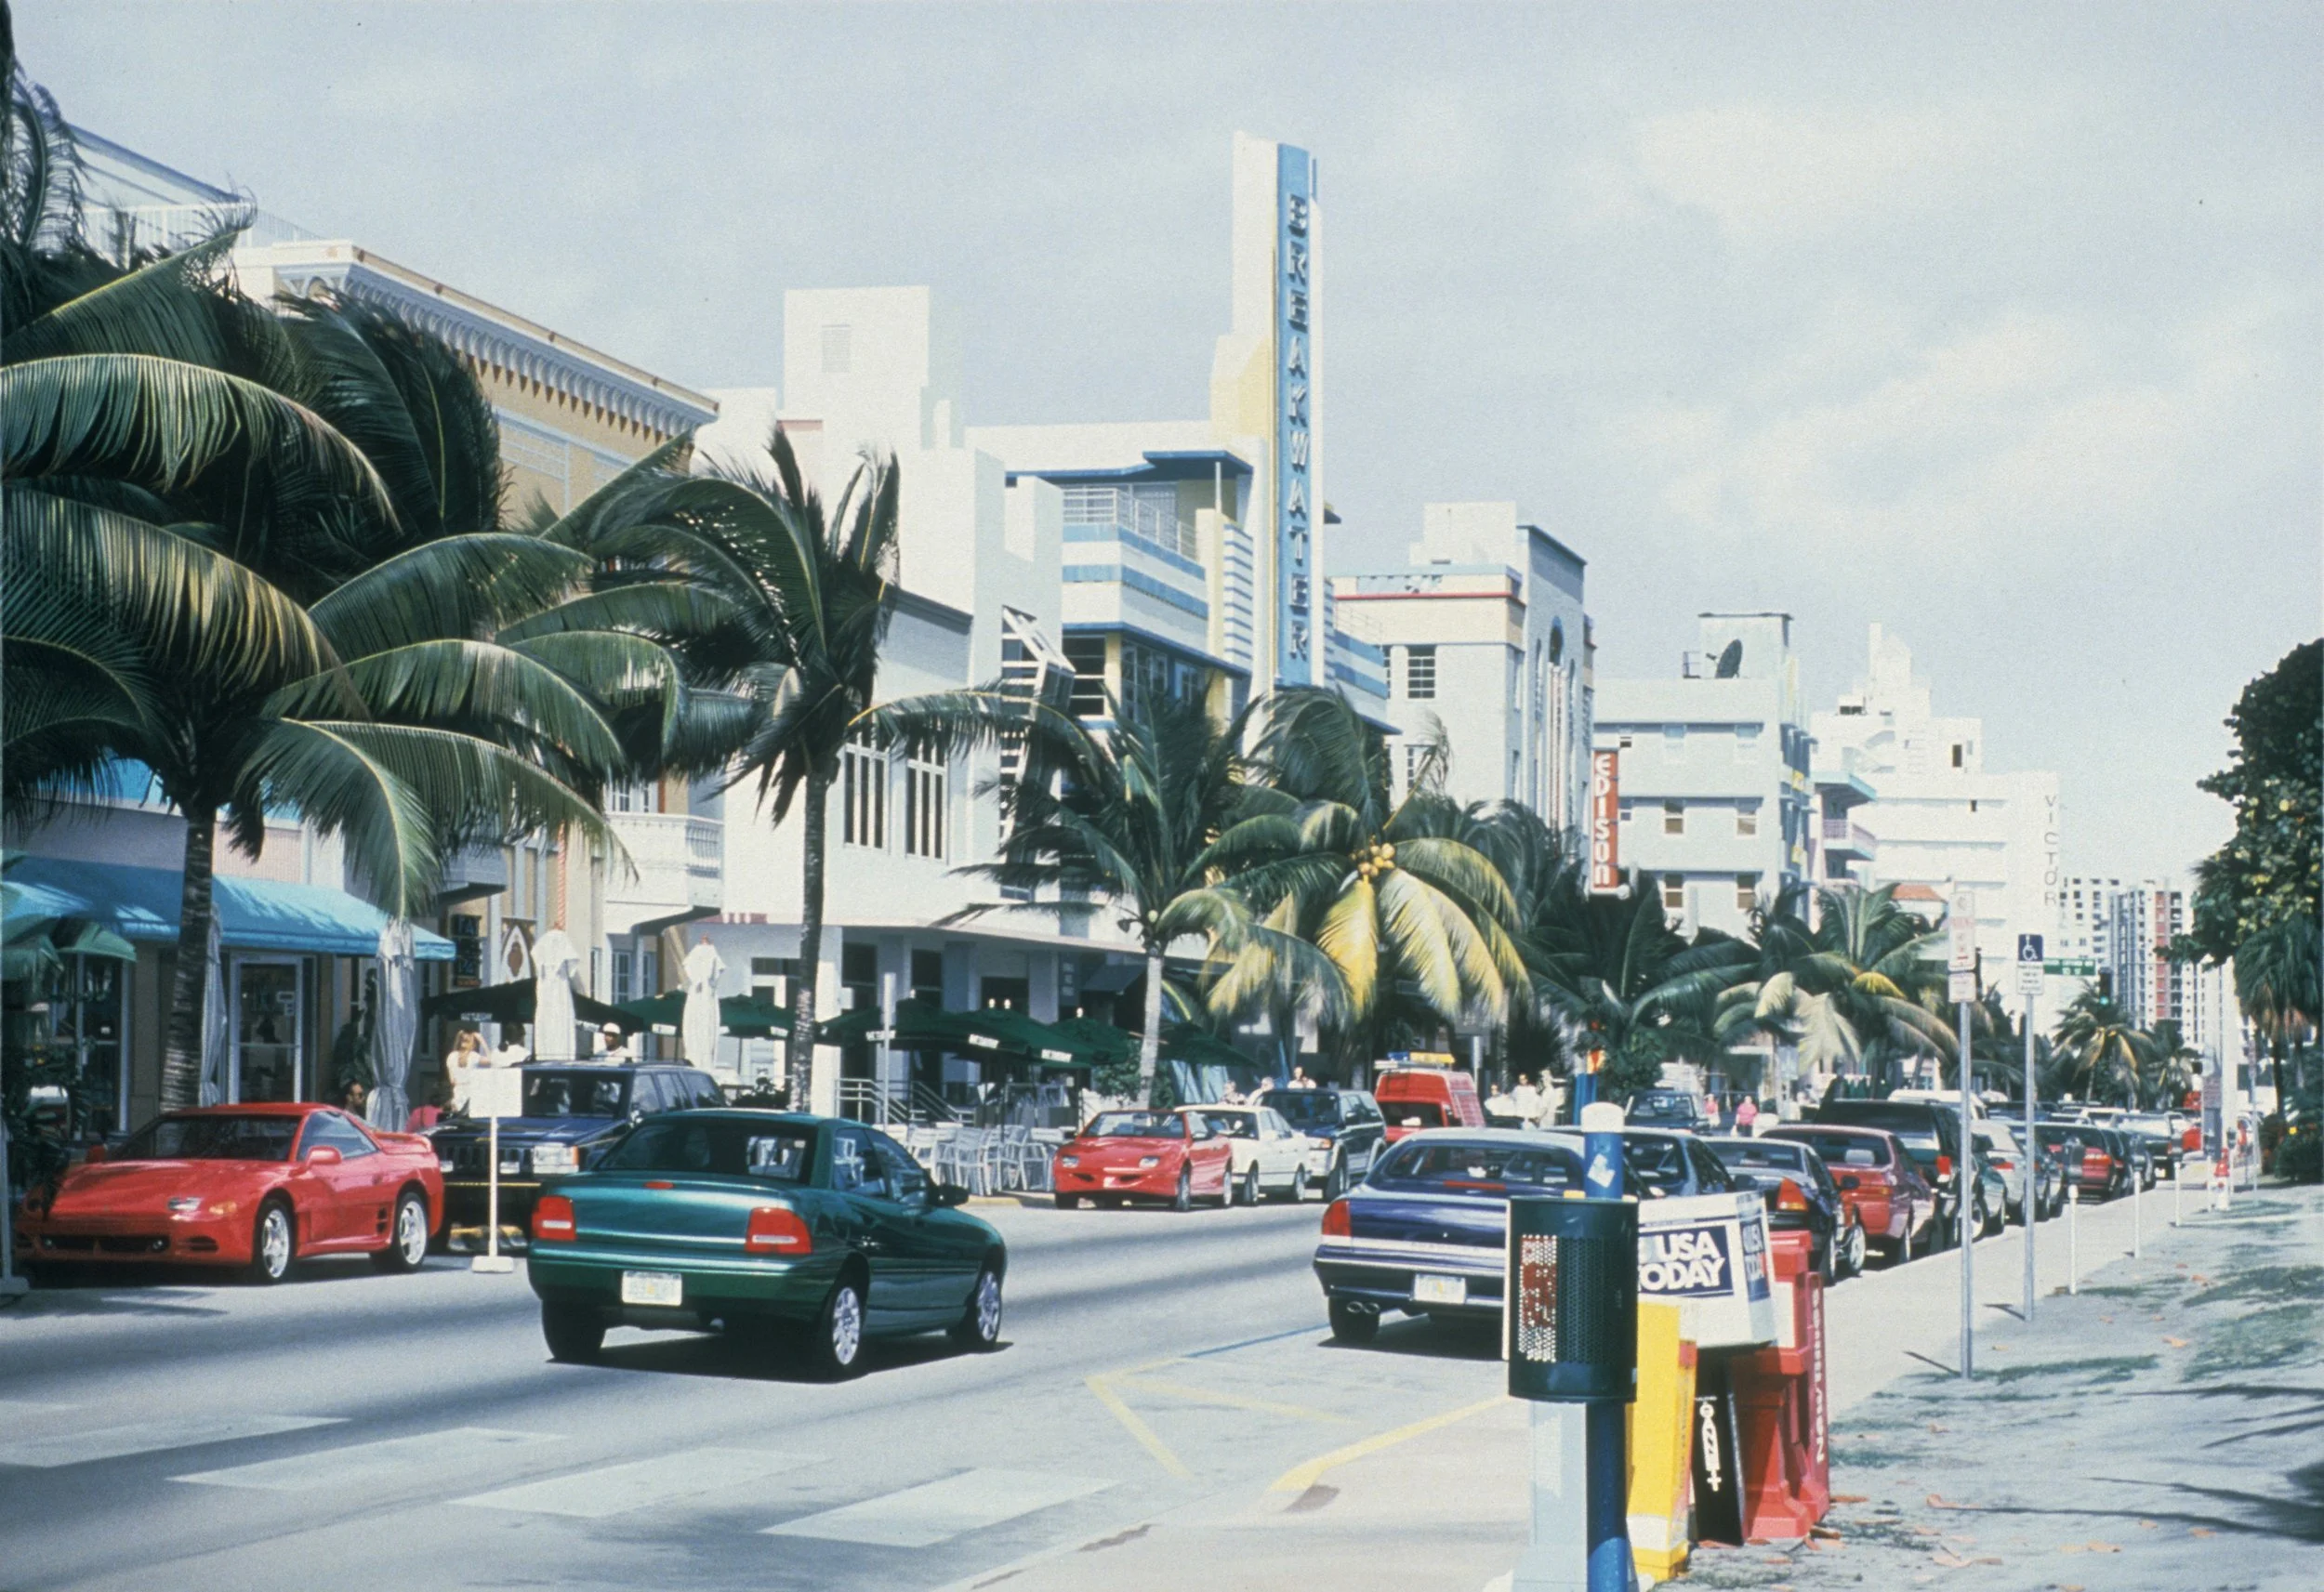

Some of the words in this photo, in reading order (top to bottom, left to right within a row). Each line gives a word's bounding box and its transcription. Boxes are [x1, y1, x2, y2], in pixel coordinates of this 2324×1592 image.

[1288, 193, 1308, 657] BREAKWATER
[2044, 795, 2059, 906] VICTOR
[1639, 1256, 1726, 1291] ODAY
[1657, 1230, 1722, 1261] USA
